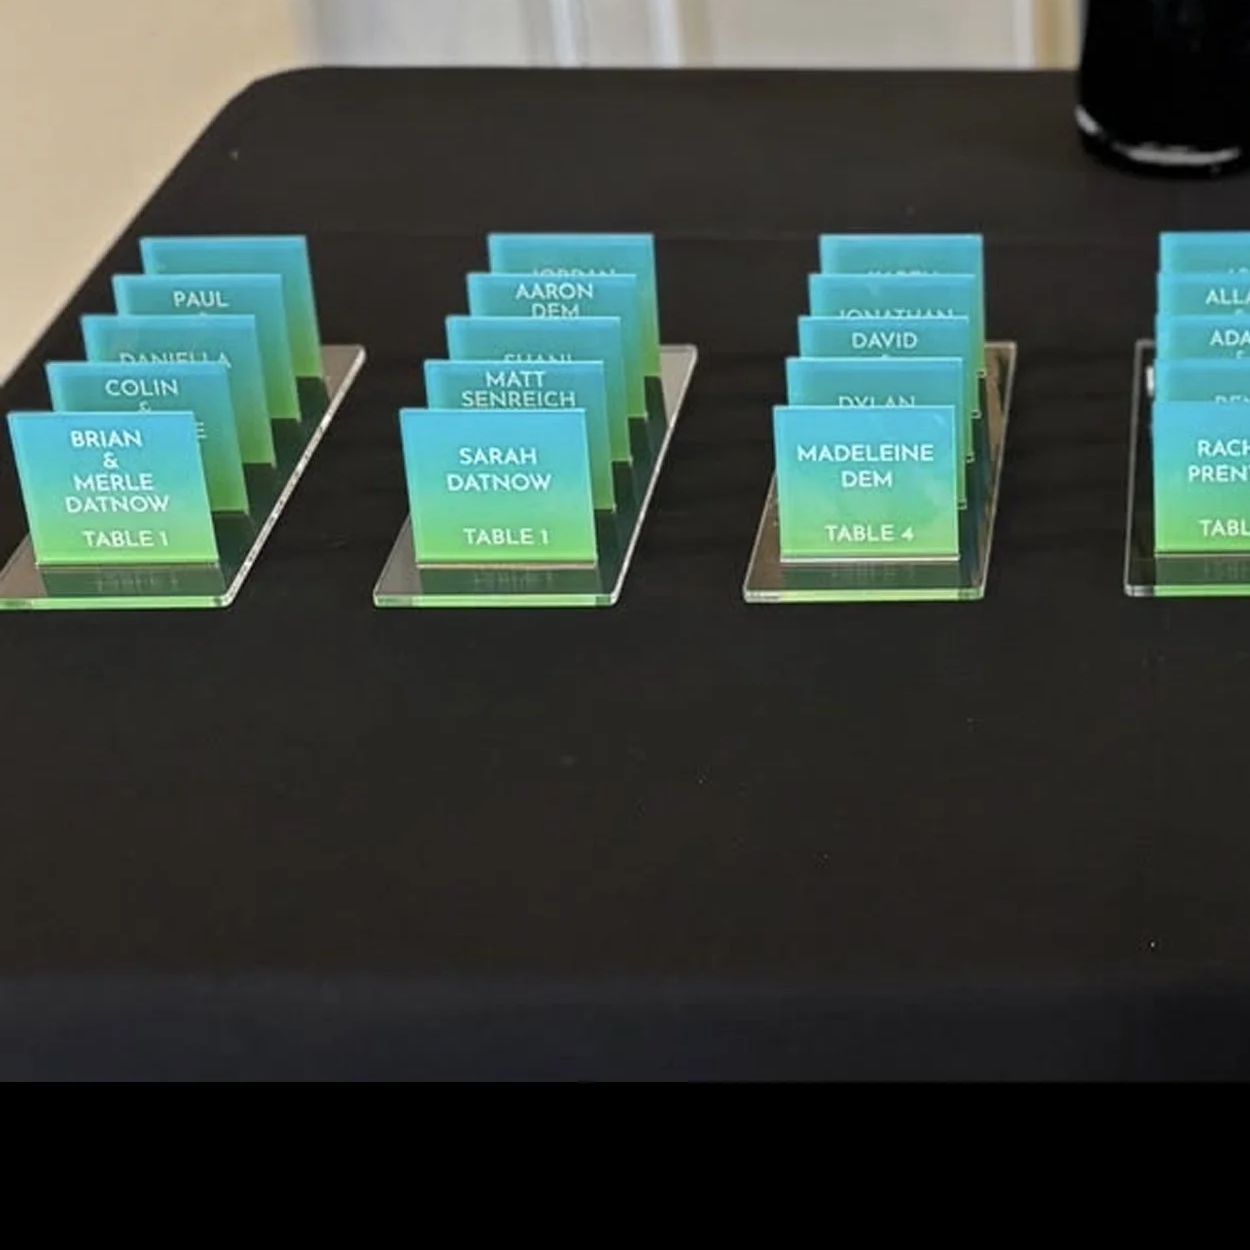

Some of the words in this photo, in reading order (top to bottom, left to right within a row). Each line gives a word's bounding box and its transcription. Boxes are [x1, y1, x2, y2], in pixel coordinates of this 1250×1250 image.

[173, 290, 229, 307] PAUL
[516, 282, 593, 299] AARON
[531, 302, 579, 318] DEM
[852, 332, 918, 349] DAVID
[105, 379, 179, 396] COLIN
[486, 371, 546, 387] MATT
[461, 391, 576, 407] SENREICH
[71, 430, 142, 447] BRIAN
[103, 452, 118, 468] &
[459, 447, 537, 465] SARAH
[797, 444, 934, 462] MADELEINE
[75, 474, 154, 491] MERLE
[447, 474, 551, 492] DATNOW
[841, 471, 892, 488] DEM
[66, 496, 169, 513] DATNOW
[83, 530, 154, 547] TABLE
[161, 530, 169, 546] 1
[463, 528, 533, 545] TABLE
[541, 528, 549, 544] 1
[824, 525, 894, 541] TABLE
[901, 525, 914, 541] 4
